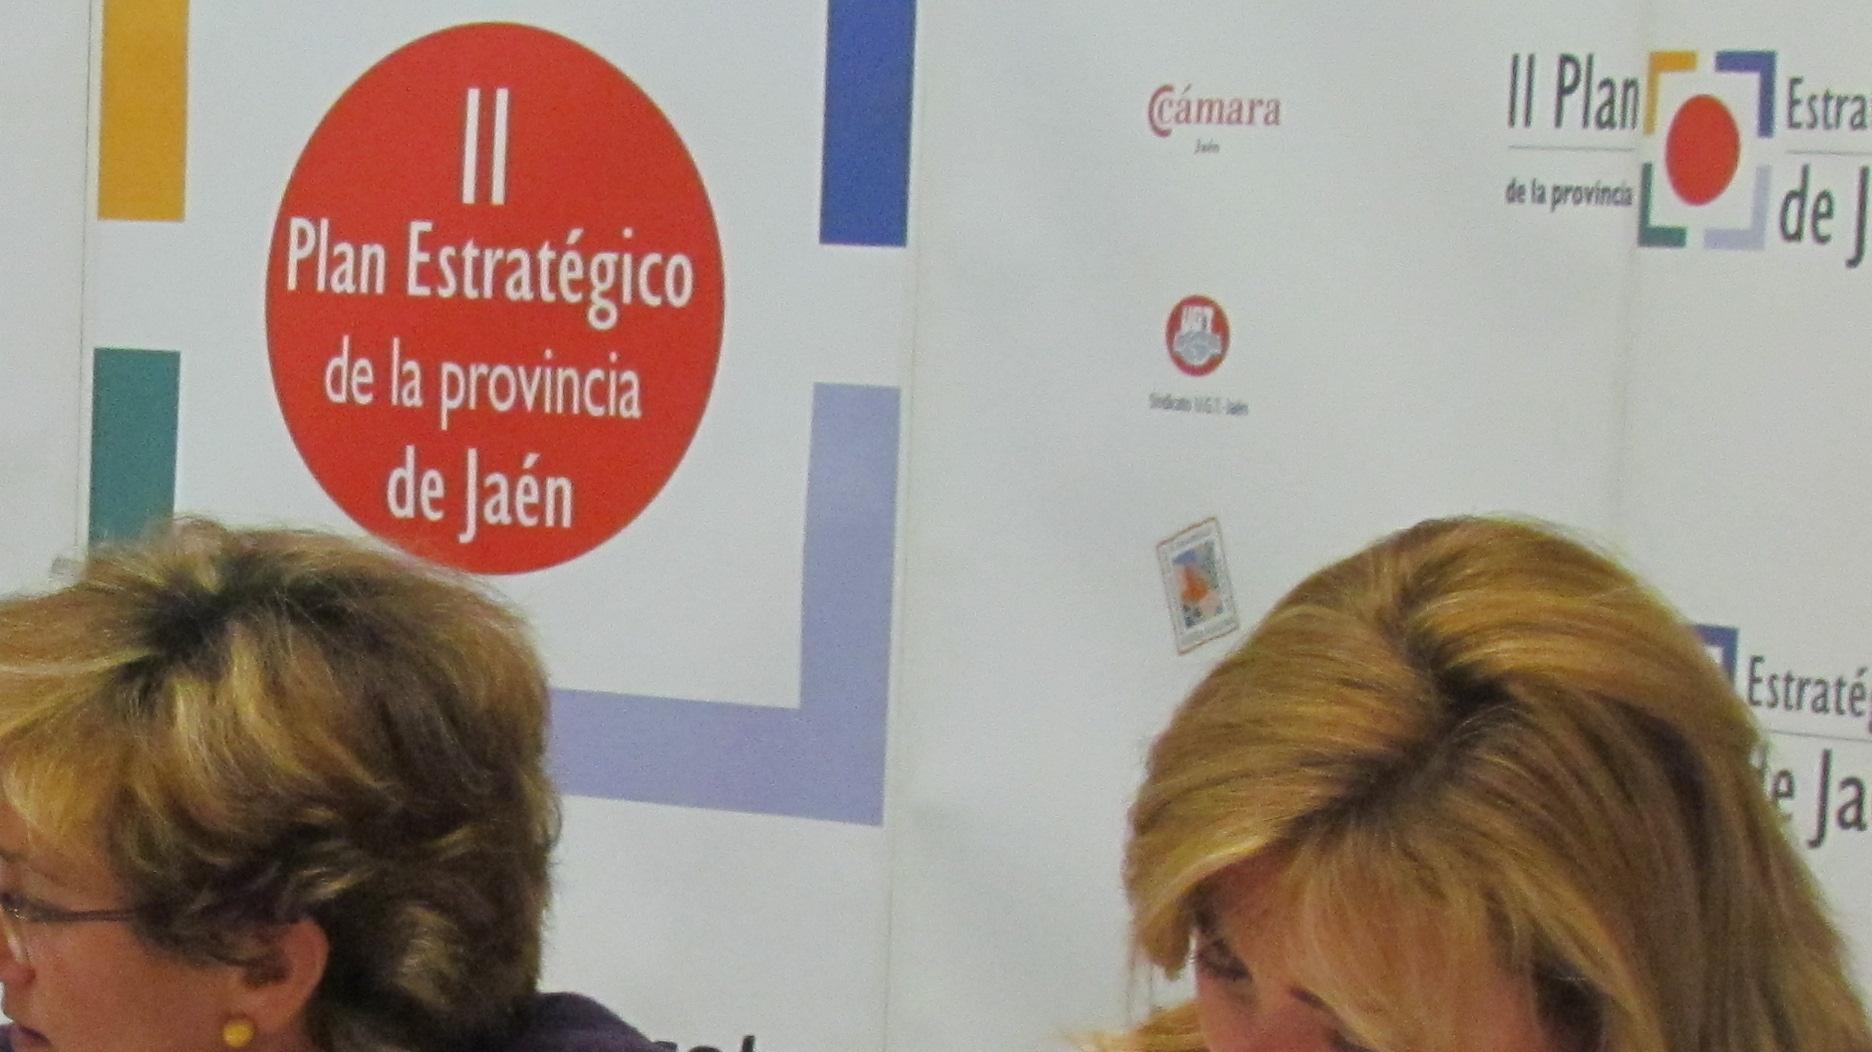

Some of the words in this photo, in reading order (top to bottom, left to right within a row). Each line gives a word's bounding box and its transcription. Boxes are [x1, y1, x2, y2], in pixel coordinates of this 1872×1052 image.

[1147, 83, 1280, 138] Cámara
[1554, 53, 1639, 130] Plan
[1787, 76, 1872, 131] Estra
[462, 88, 509, 205] II
[1505, 177, 1526, 204] de
[1531, 178, 1546, 205] la
[1550, 179, 1633, 212] provincia
[1780, 163, 1834, 246] de
[287, 217, 386, 295] Plan
[406, 220, 693, 330] Estratégico
[325, 335, 374, 405] de
[390, 337, 423, 408] la
[440, 349, 642, 431] provincia
[386, 445, 445, 521] de
[458, 448, 574, 544] Jaén
[1746, 654, 1872, 734] Estraté
[1807, 748, 1872, 849] Ja
